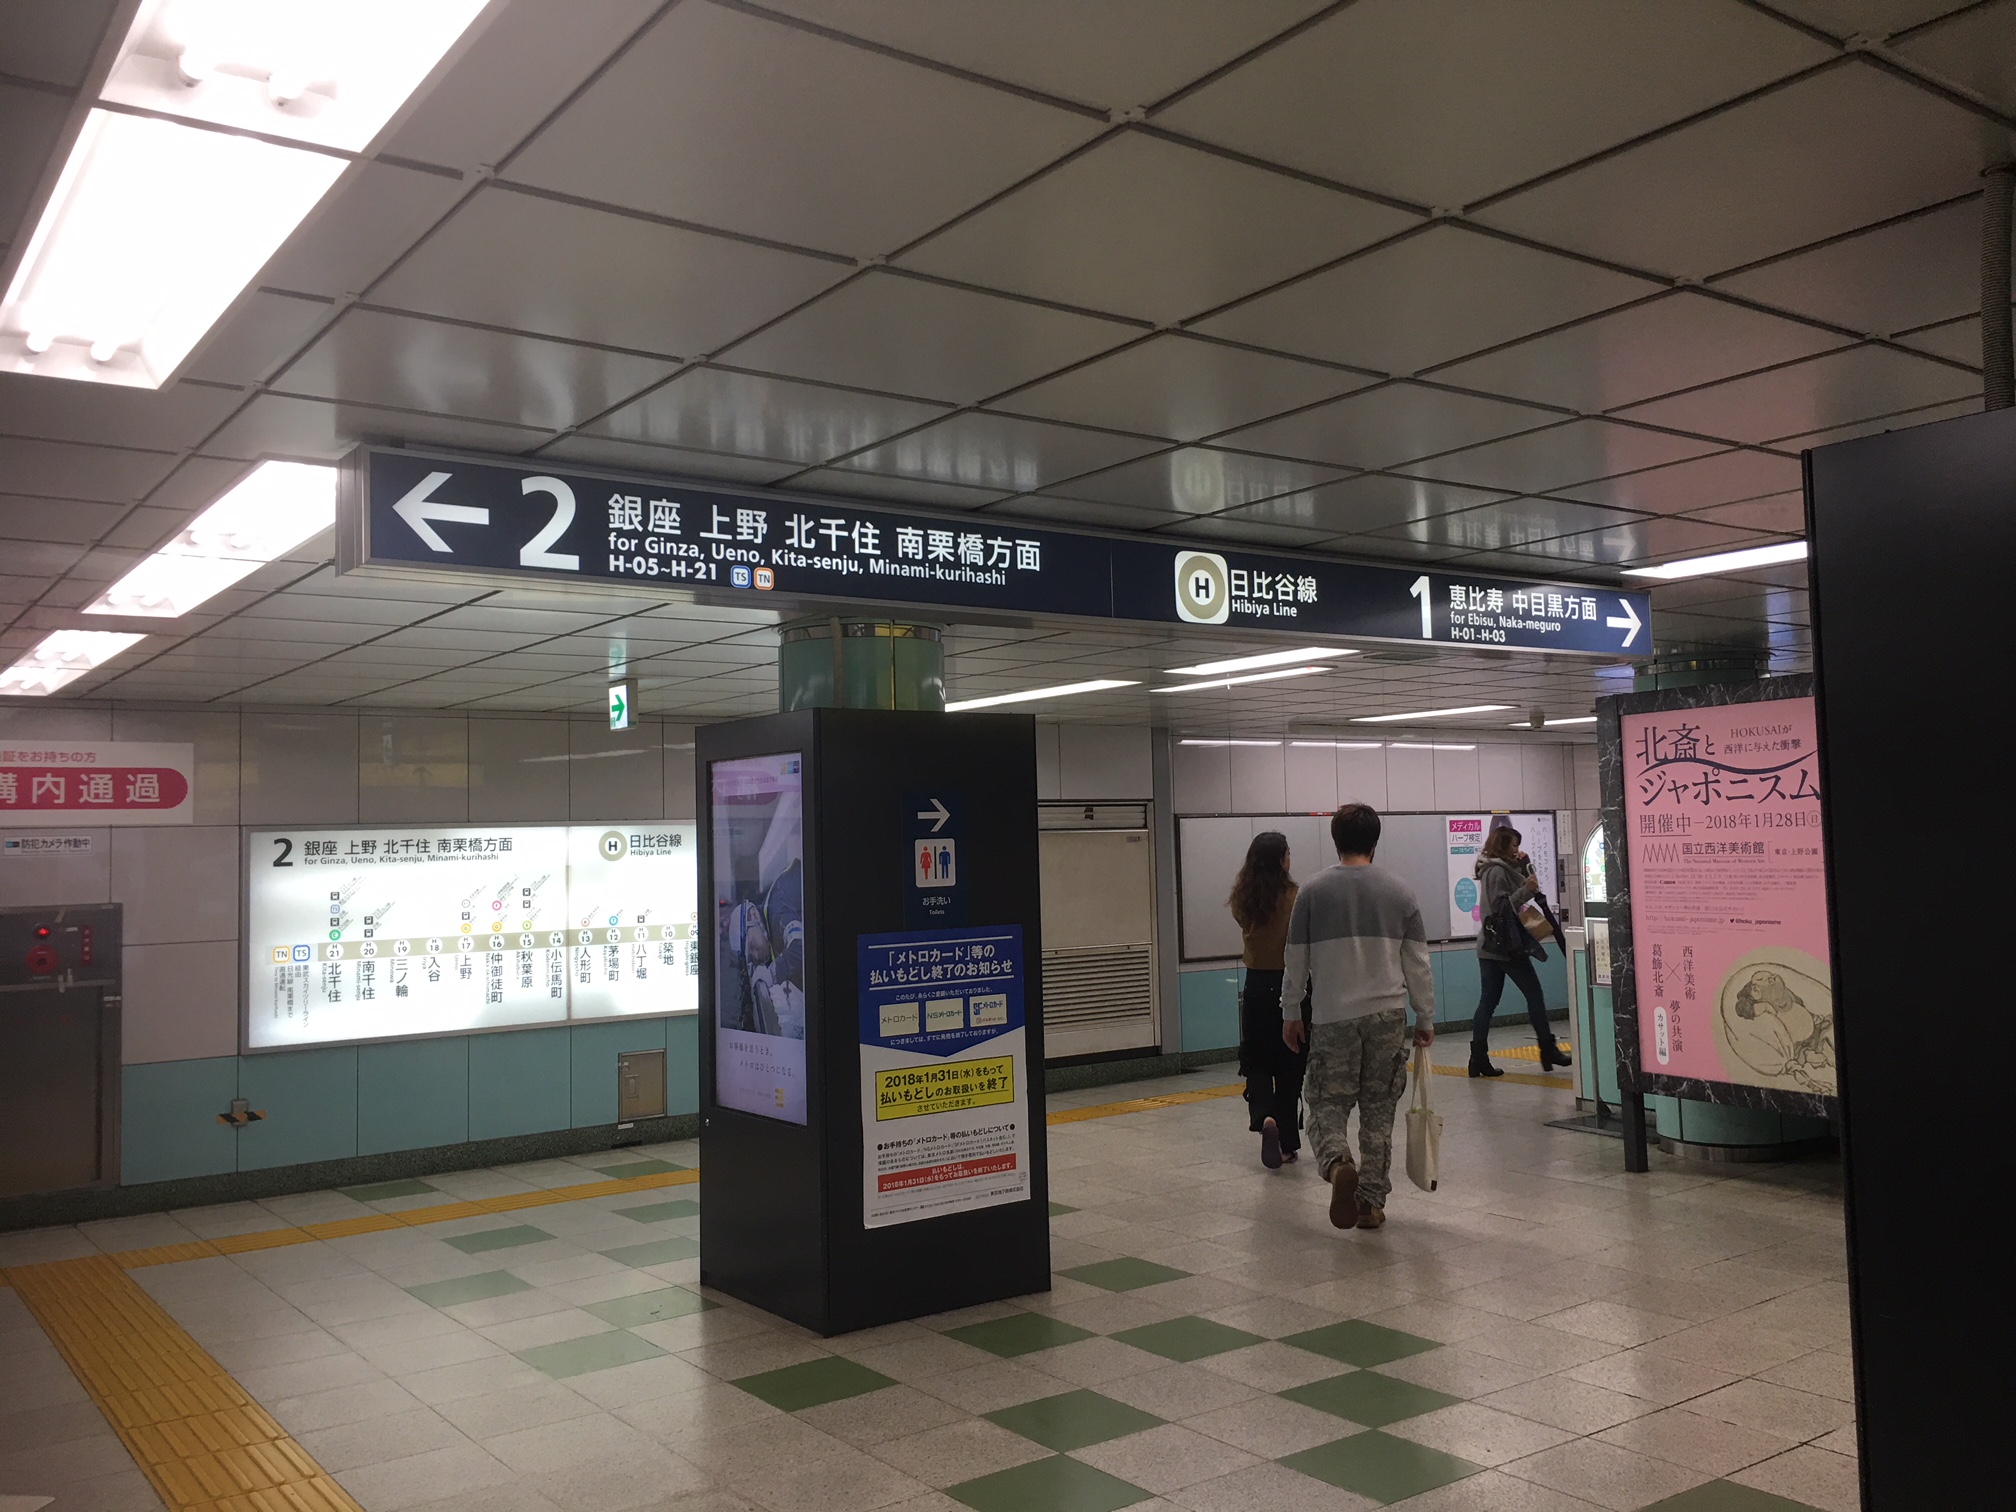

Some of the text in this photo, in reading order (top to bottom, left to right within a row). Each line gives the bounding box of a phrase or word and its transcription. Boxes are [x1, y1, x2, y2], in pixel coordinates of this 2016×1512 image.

[520, 476, 580, 570] 2
[608, 494, 1040, 571] 銀座 上野 北千住 南栗橋方面
[608, 533, 1006, 585] for Ginza, Ueno, Kita-senju, Minami-kurihashi
[735, 572, 747, 582] TS
[758, 574, 770, 584] TN
[1194, 576, 1210, 598] H
[1231, 570, 1318, 603] 日比谷線
[1232, 599, 1297, 617] Hibiya Line
[1410, 576, 1432, 638] 1
[1449, 584, 1597, 621] 恵比寿 中目黒方面
[1450, 611, 1561, 632] for Ebisu, Naka-meguro
[1730, 724, 1792, 738] HOKUSAIが
[1636, 723, 1715, 765] 北斎と
[1724, 738, 1801, 754] 西洋に与えた衝撃
[0, 751, 96, 763] 証をお持ちの方
[1640, 768, 1821, 806] ジャポニスム
[1452, 822, 1480, 831] メディカル
[1452, 834, 1480, 842] ハーブ検定
[22, 838, 90, 849] 防犯カメラ作動中
[273, 838, 293, 867] 2
[304, 837, 512, 856] 銀座 上野 北千住 南栗橋方面
[608, 840, 618, 851] H
[630, 834, 682, 848] 日比谷線
[630, 848, 654, 857] Hibiya
[1682, 841, 1764, 855] 国立西洋美術館
[304, 853, 498, 865] for Ginza, Ueno, Kita-senju, Minami-kurihashi
[922, 896, 950, 906] お手洗い
[276, 950, 288, 958] TN
[580, 947, 591, 984] 人形町
[608, 946, 619, 981] 茅場町
[636, 944, 647, 979] 八丁堀
[663, 942, 674, 965] 築地
[690, 941, 698, 976] 東銀座
[889, 945, 995, 966] 「メトロカード」等の
[362, 960, 375, 1000] 南千住
[396, 958, 408, 998] 三ノ輪
[428, 956, 440, 982] 入谷
[460, 955, 472, 980] 上野
[491, 952, 502, 1004] 仲御徒町
[521, 951, 532, 988] 秋葉原
[551, 949, 562, 998] 小伝馬町
[870, 960, 1012, 984] 払いもどし終了のお知らせ
[1652, 944, 1664, 998] 葛飾北斎
[1682, 946, 1696, 1000] 西洋美術
[328, 963, 342, 1002] 北千住
[882, 1014, 918, 1024] メトロカード
[1670, 1000, 1684, 1052] 夢の共演
[1657, 1014, 1666, 1057] カサット編
[880, 1076, 1008, 1104] 払いもどしのお取扱いを終了
[917, 1098, 976, 1112] させていただきます。
